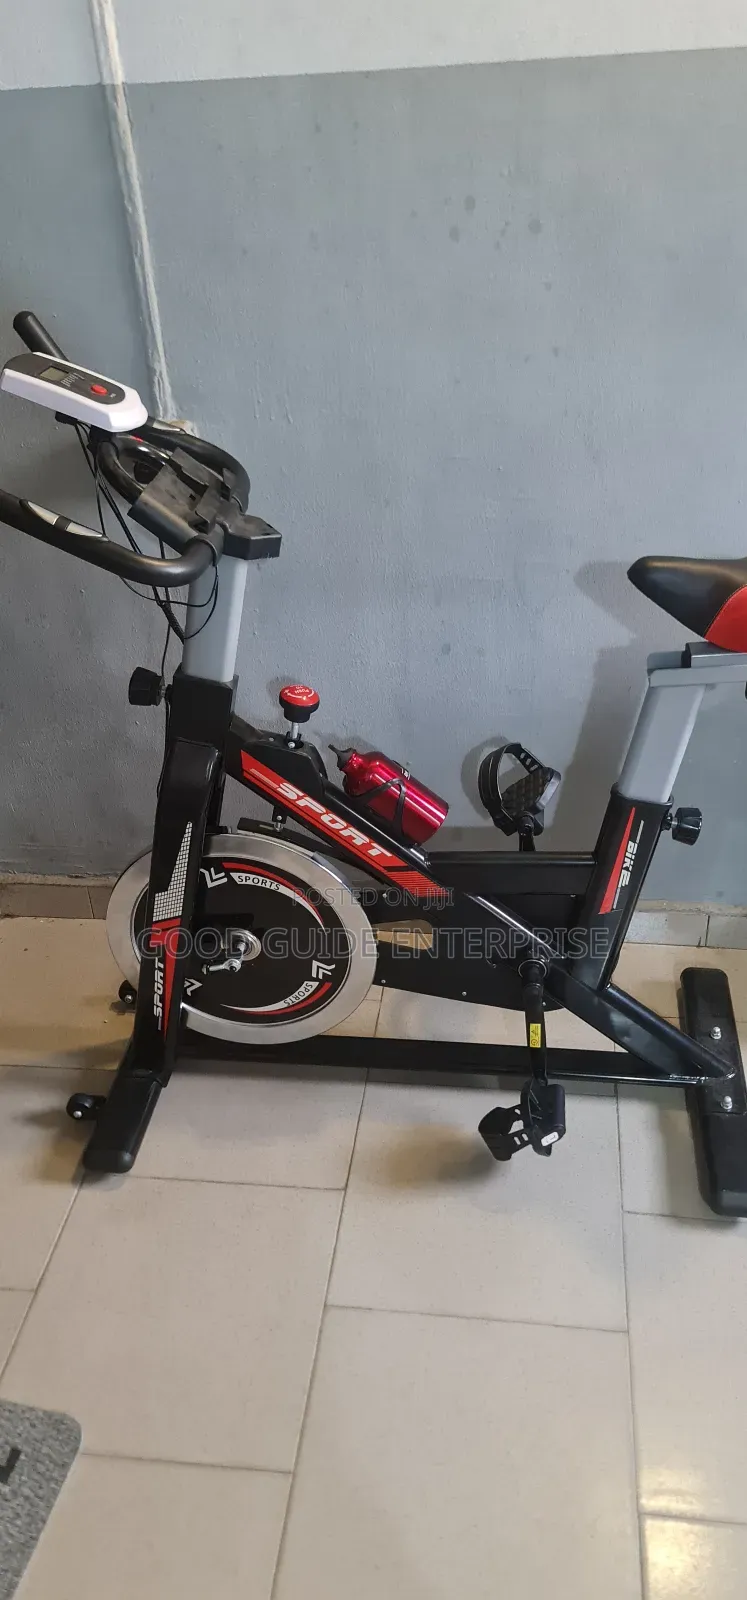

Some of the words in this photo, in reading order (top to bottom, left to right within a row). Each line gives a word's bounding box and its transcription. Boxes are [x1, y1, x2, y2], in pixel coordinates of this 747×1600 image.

[276, 782, 392, 857] SPORT
[237, 875, 281, 891] SPORTS
[153, 956, 165, 1018] SPORT
[283, 982, 313, 1006] SPORTS
